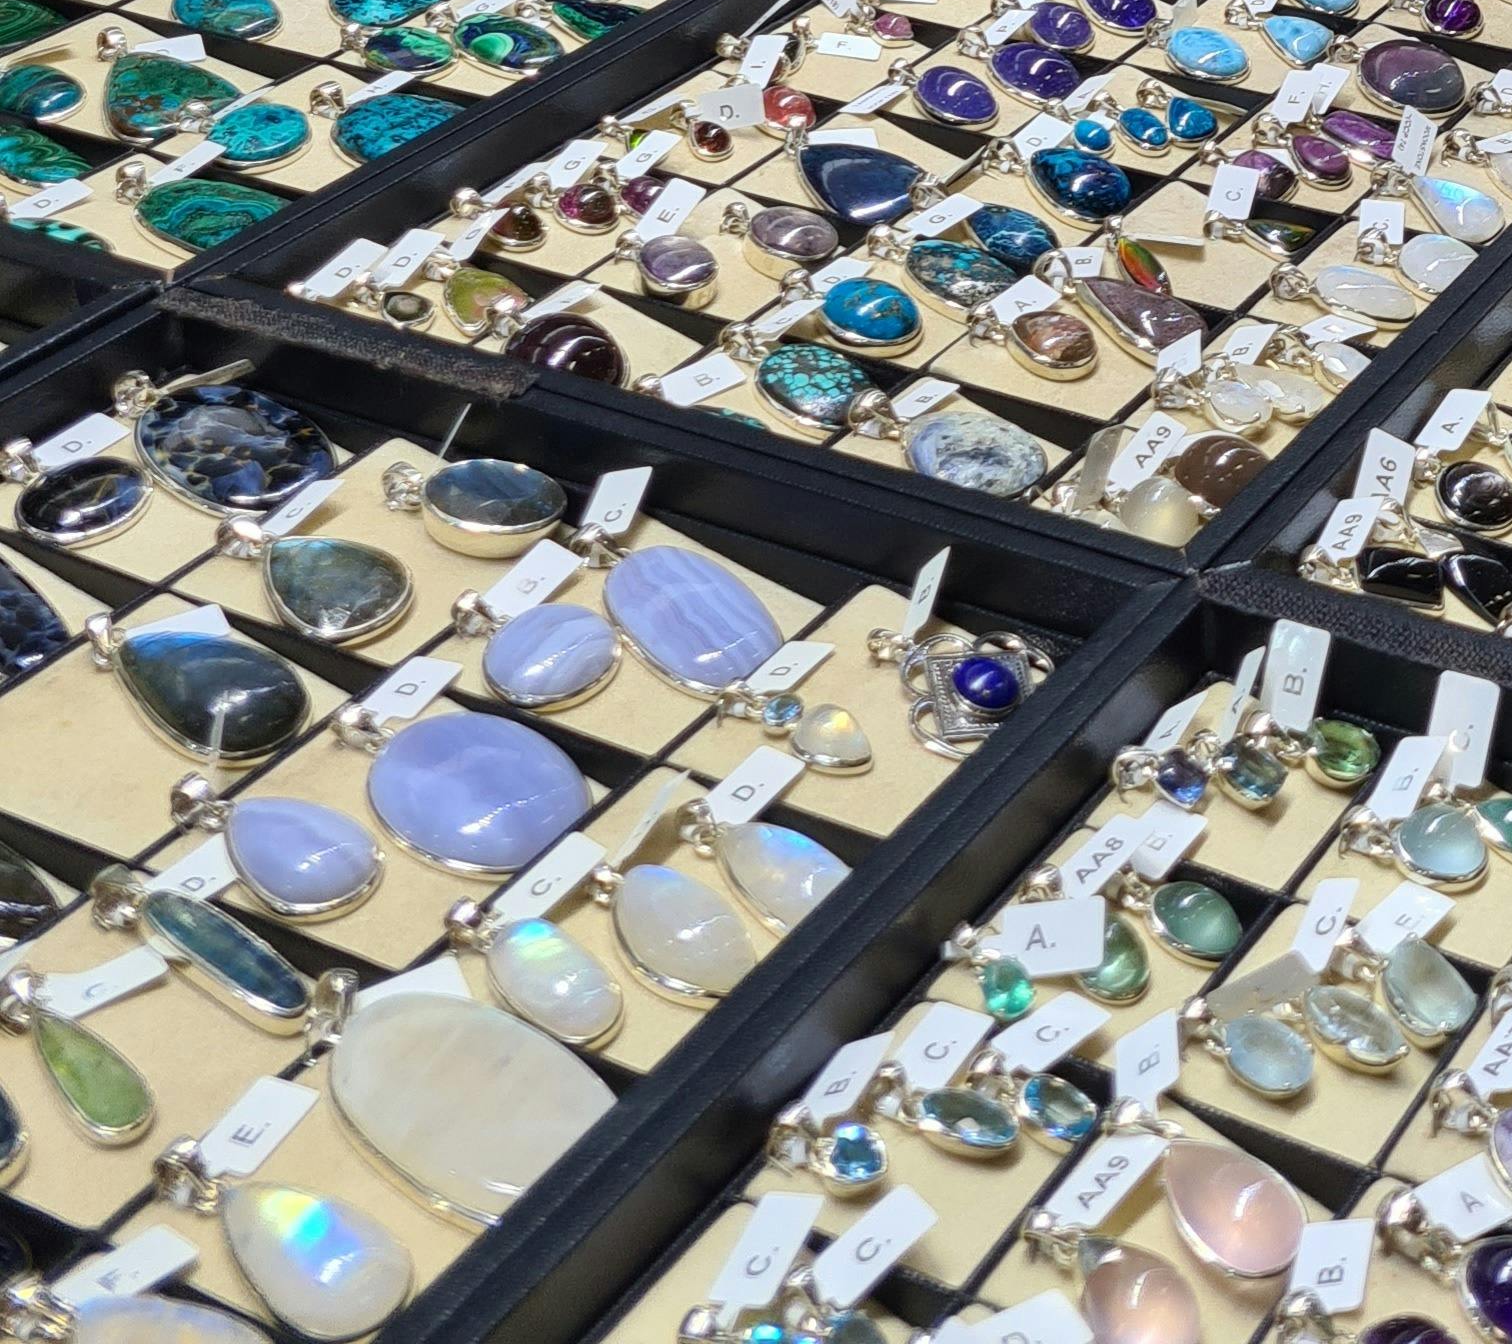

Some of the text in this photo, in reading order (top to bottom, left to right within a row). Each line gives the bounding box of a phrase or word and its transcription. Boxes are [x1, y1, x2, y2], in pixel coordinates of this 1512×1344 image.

[1135, 426, 1171, 468] AA9
[1331, 514, 1363, 551] AA9
[1076, 838, 1123, 884] AA8
[1078, 1156, 1129, 1209] AA9
